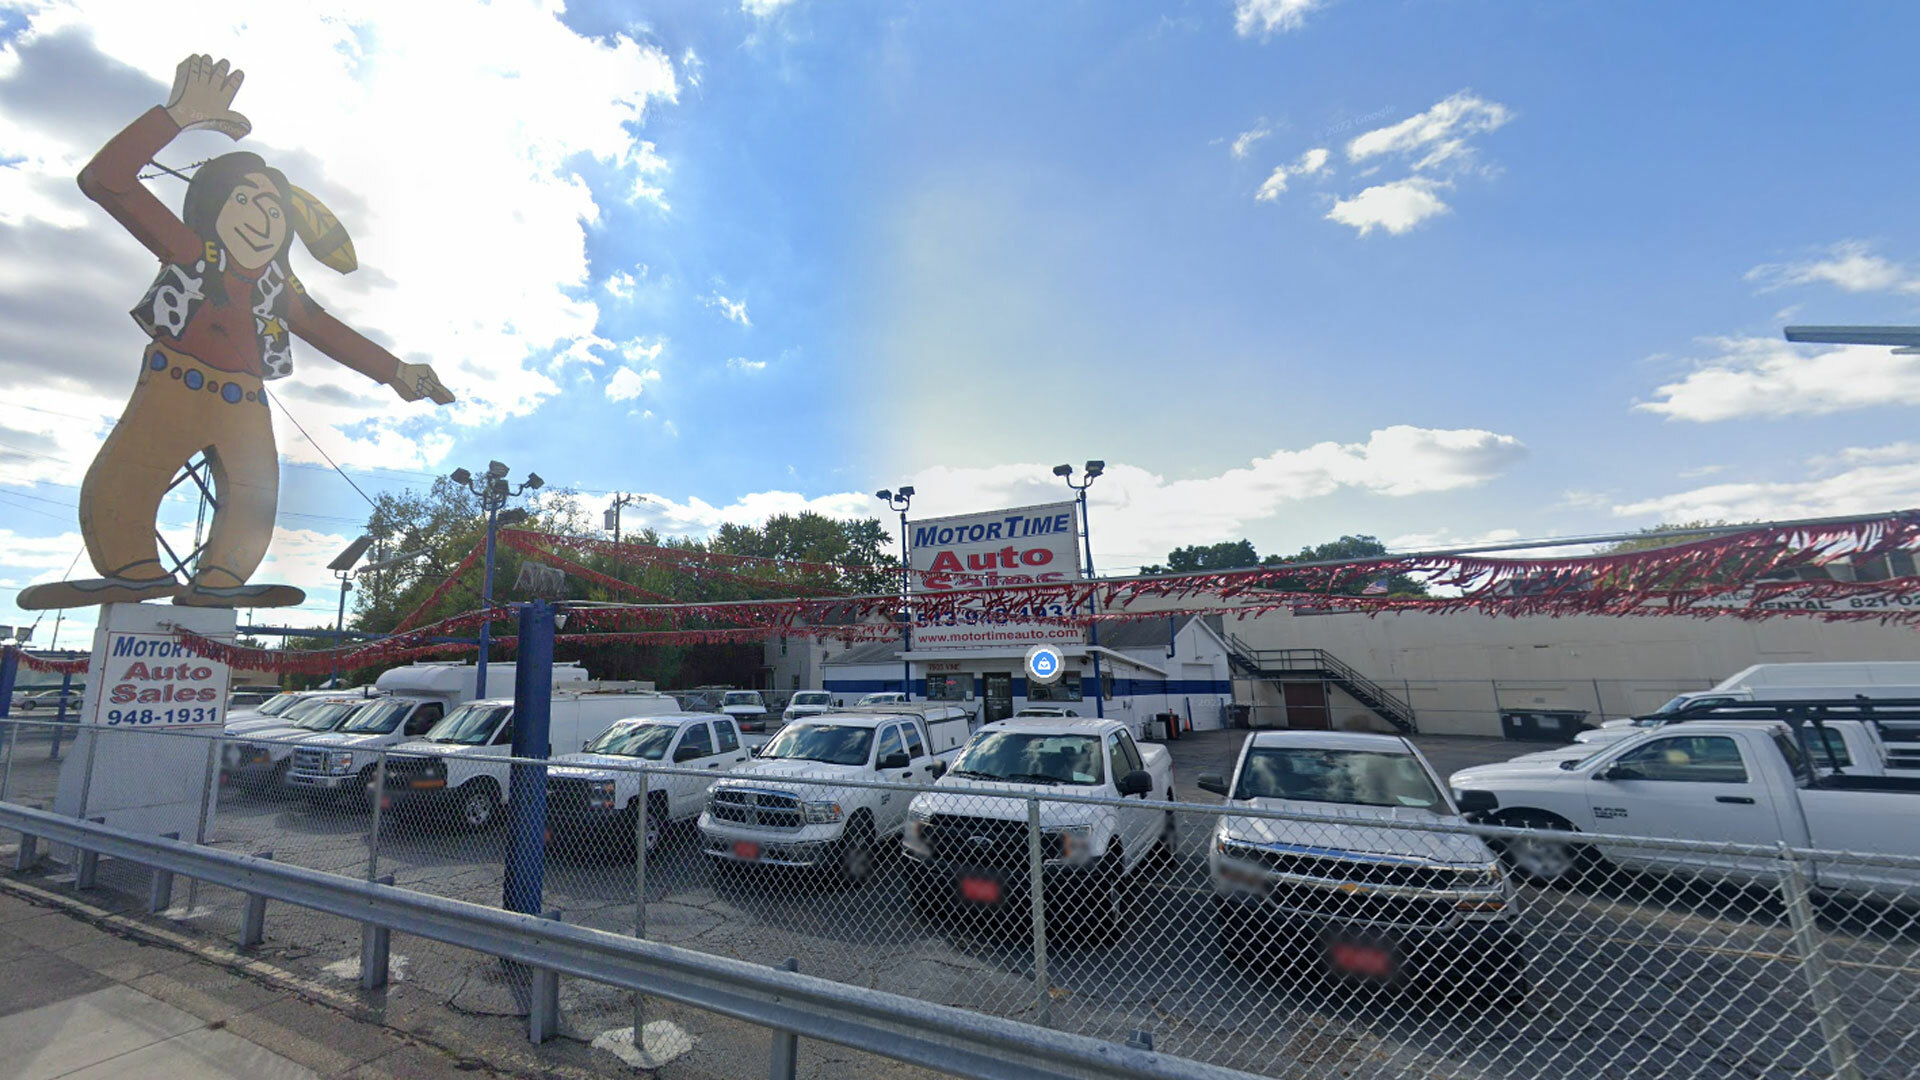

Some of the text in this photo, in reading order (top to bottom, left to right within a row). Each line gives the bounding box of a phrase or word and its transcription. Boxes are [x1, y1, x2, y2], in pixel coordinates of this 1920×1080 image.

[929, 546, 1054, 572] Auto
[918, 628, 1079, 643] www.motortimeauto.com
[121, 662, 212, 681] Auto
[110, 684, 217, 704] Sales
[108, 707, 217, 725] 948-1931
